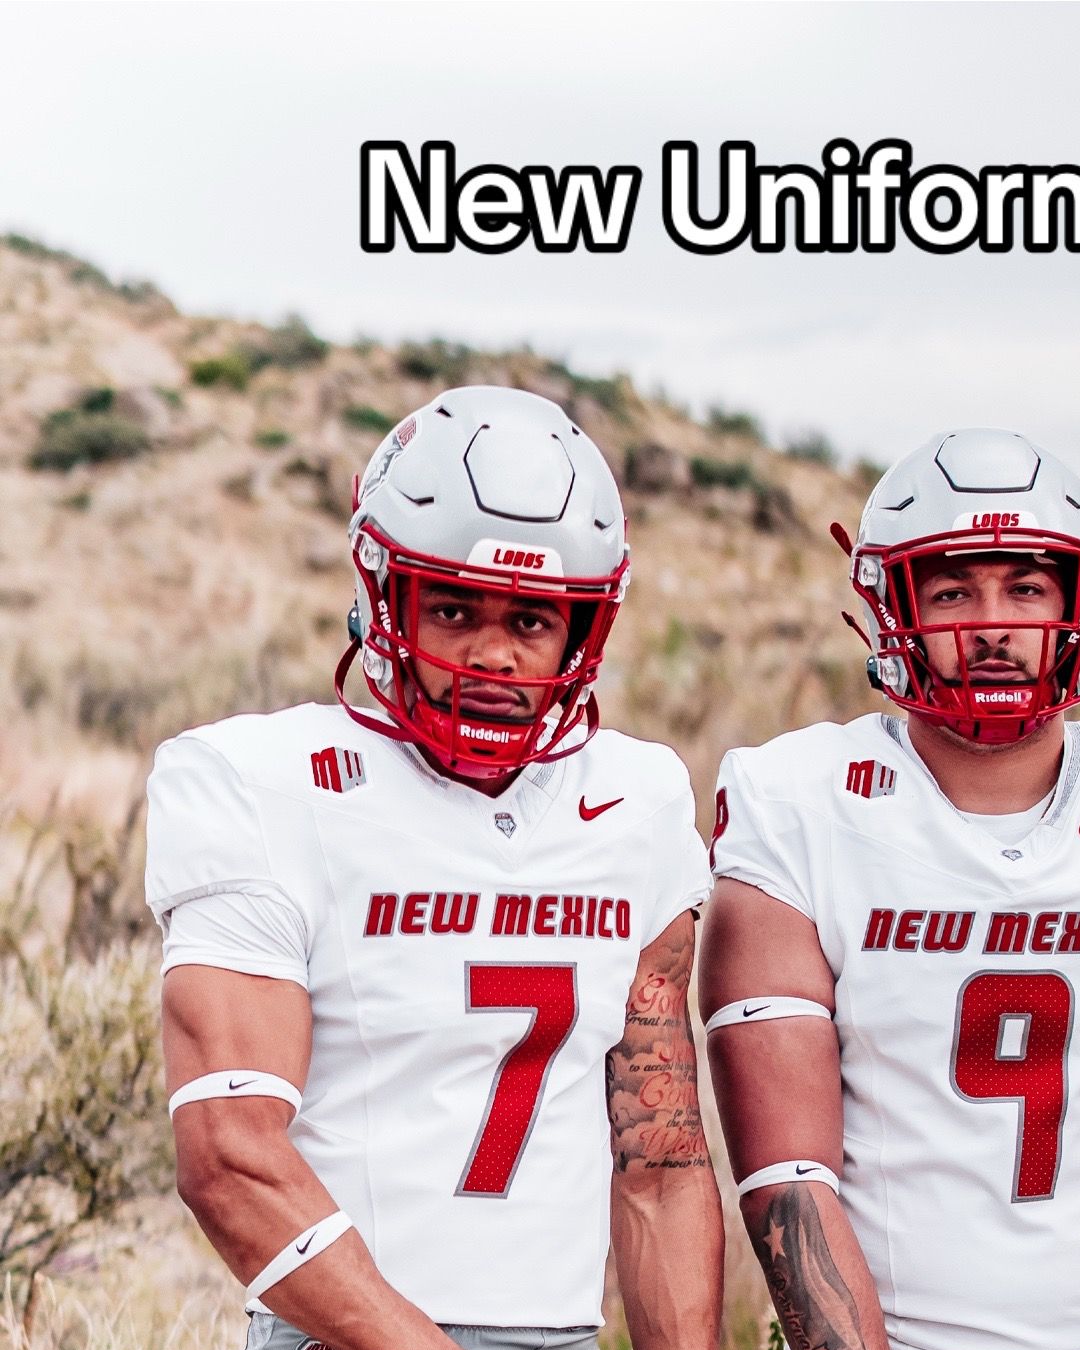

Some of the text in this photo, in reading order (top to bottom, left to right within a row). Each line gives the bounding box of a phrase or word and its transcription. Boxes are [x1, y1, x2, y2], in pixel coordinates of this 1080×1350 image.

[972, 512, 1020, 529] LOBOS
[493, 548, 546, 569] LOBOS
[974, 691, 1022, 703] Riddell
[460, 724, 510, 744] Riddell
[363, 890, 633, 941] NEW MEXICO
[861, 907, 975, 951] NEW
[453, 961, 579, 1199] 7
[949, 968, 1075, 1203] 9
